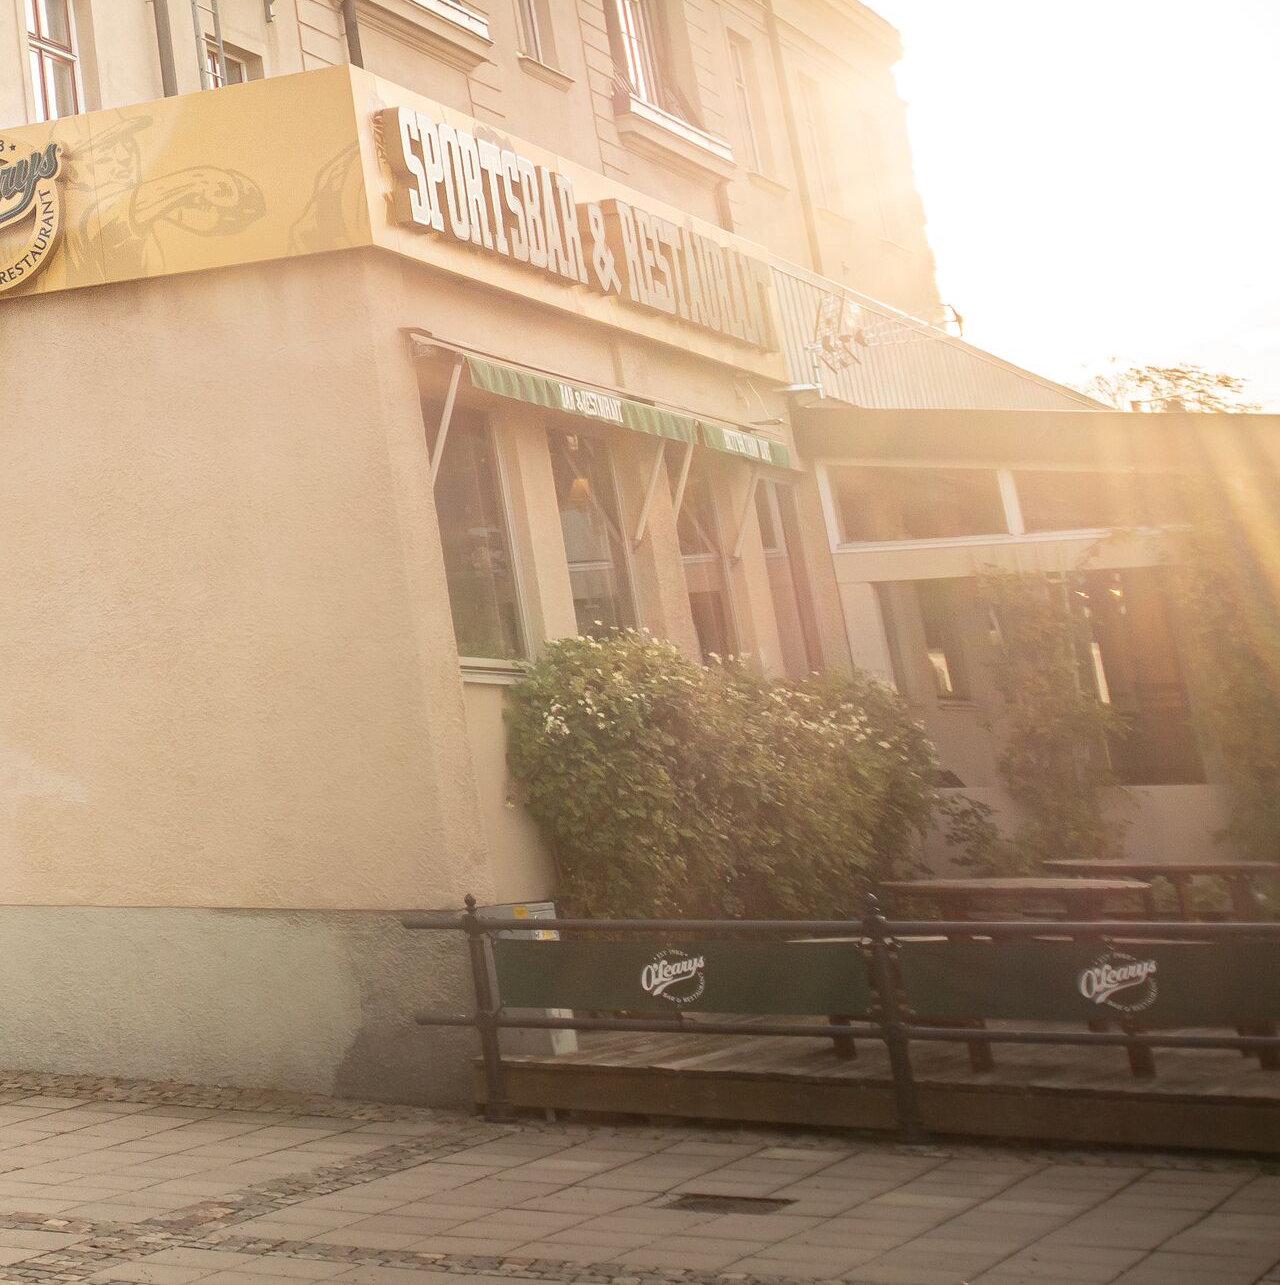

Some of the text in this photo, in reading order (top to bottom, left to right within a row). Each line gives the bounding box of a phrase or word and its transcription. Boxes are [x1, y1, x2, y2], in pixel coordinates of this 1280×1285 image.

[398, 106, 778, 353] SPORTSBAR & RESTAURANT
